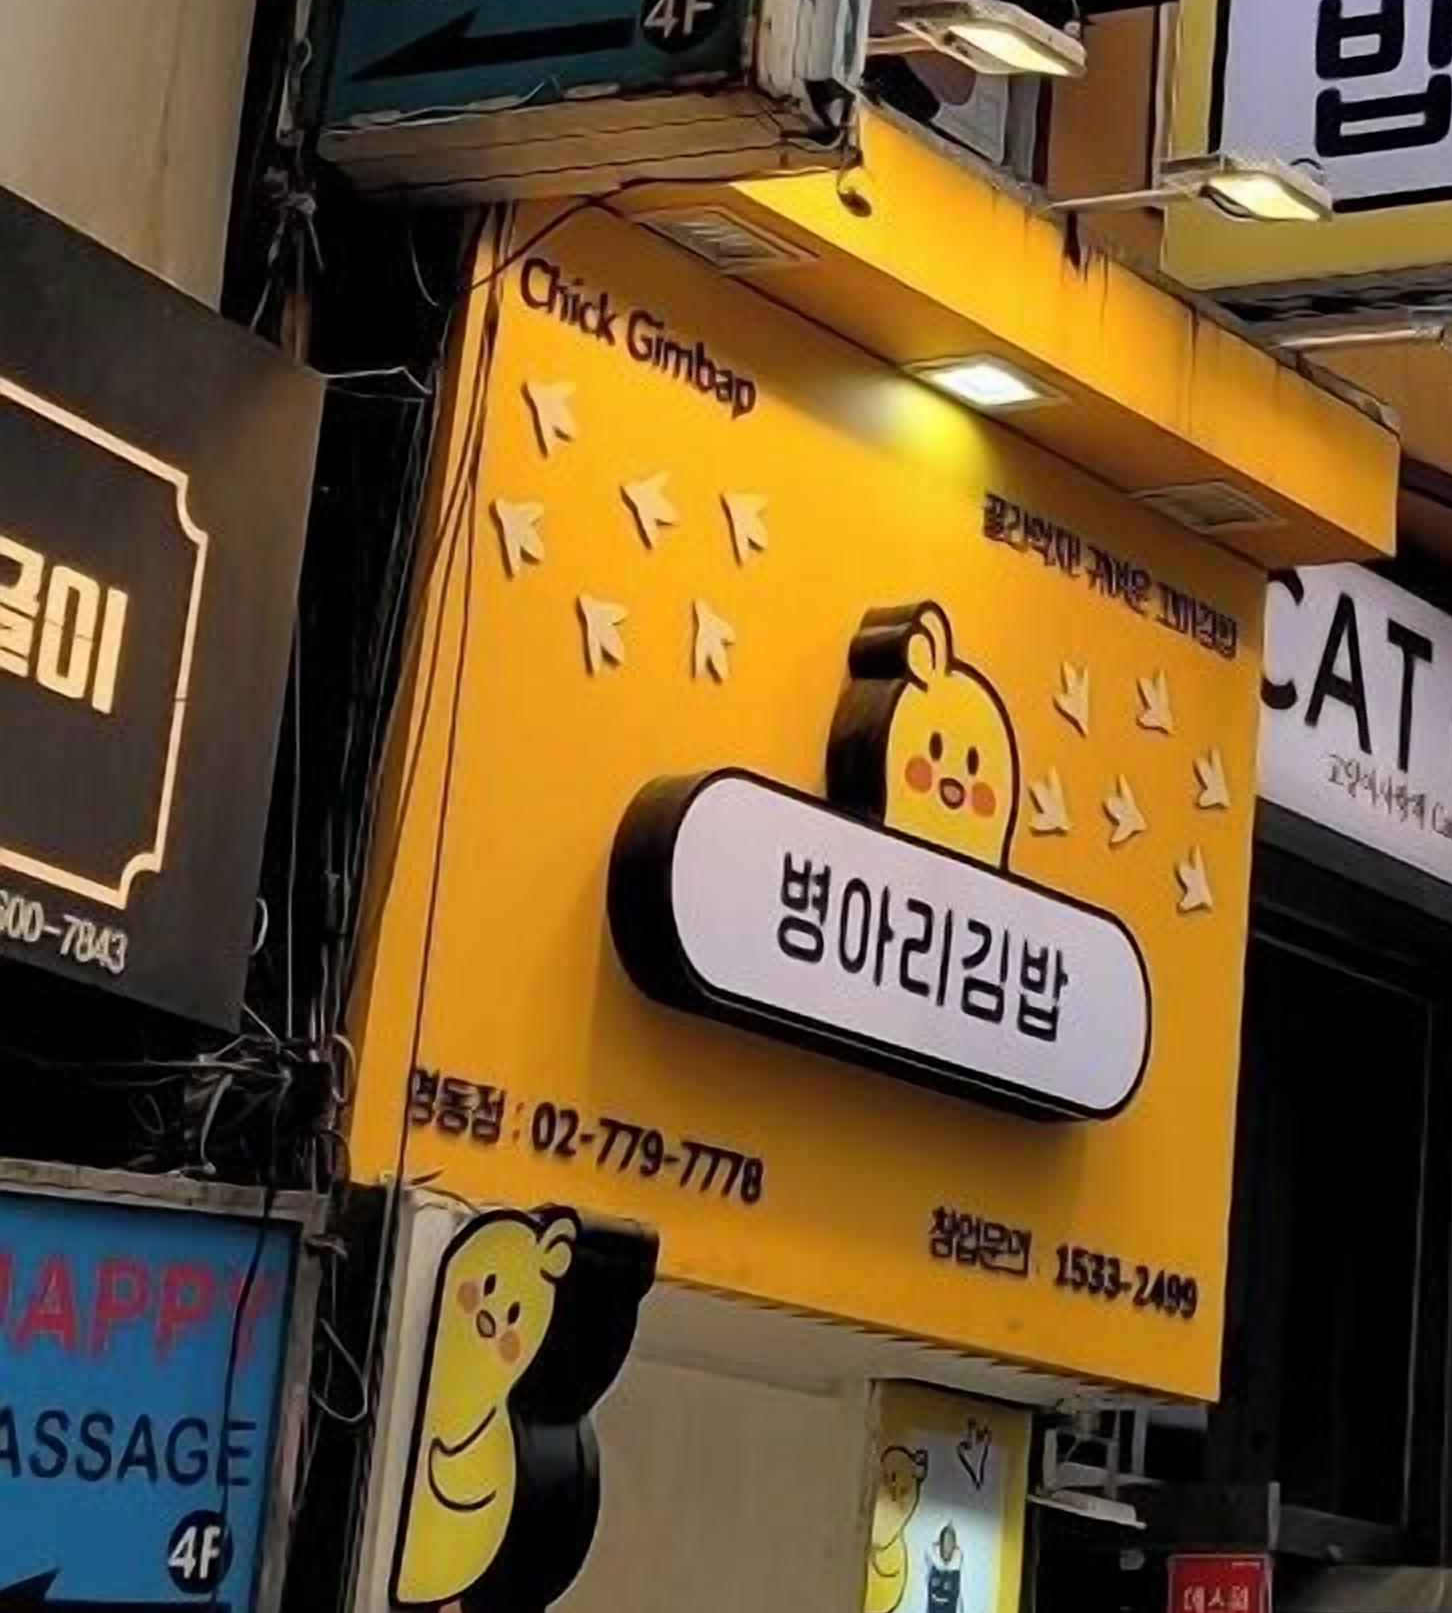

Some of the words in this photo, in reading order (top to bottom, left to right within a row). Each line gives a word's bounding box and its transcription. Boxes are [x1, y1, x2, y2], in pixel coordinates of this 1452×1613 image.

[521, 256, 617, 348] Chick
[626, 311, 758, 419] Gimbap
[1260, 568, 1433, 773] CAT
[776, 851, 1070, 1044] 병아리김밥
[531, 1102, 764, 1204] 02-779-7778
[166, 1526, 226, 1579] 4F
